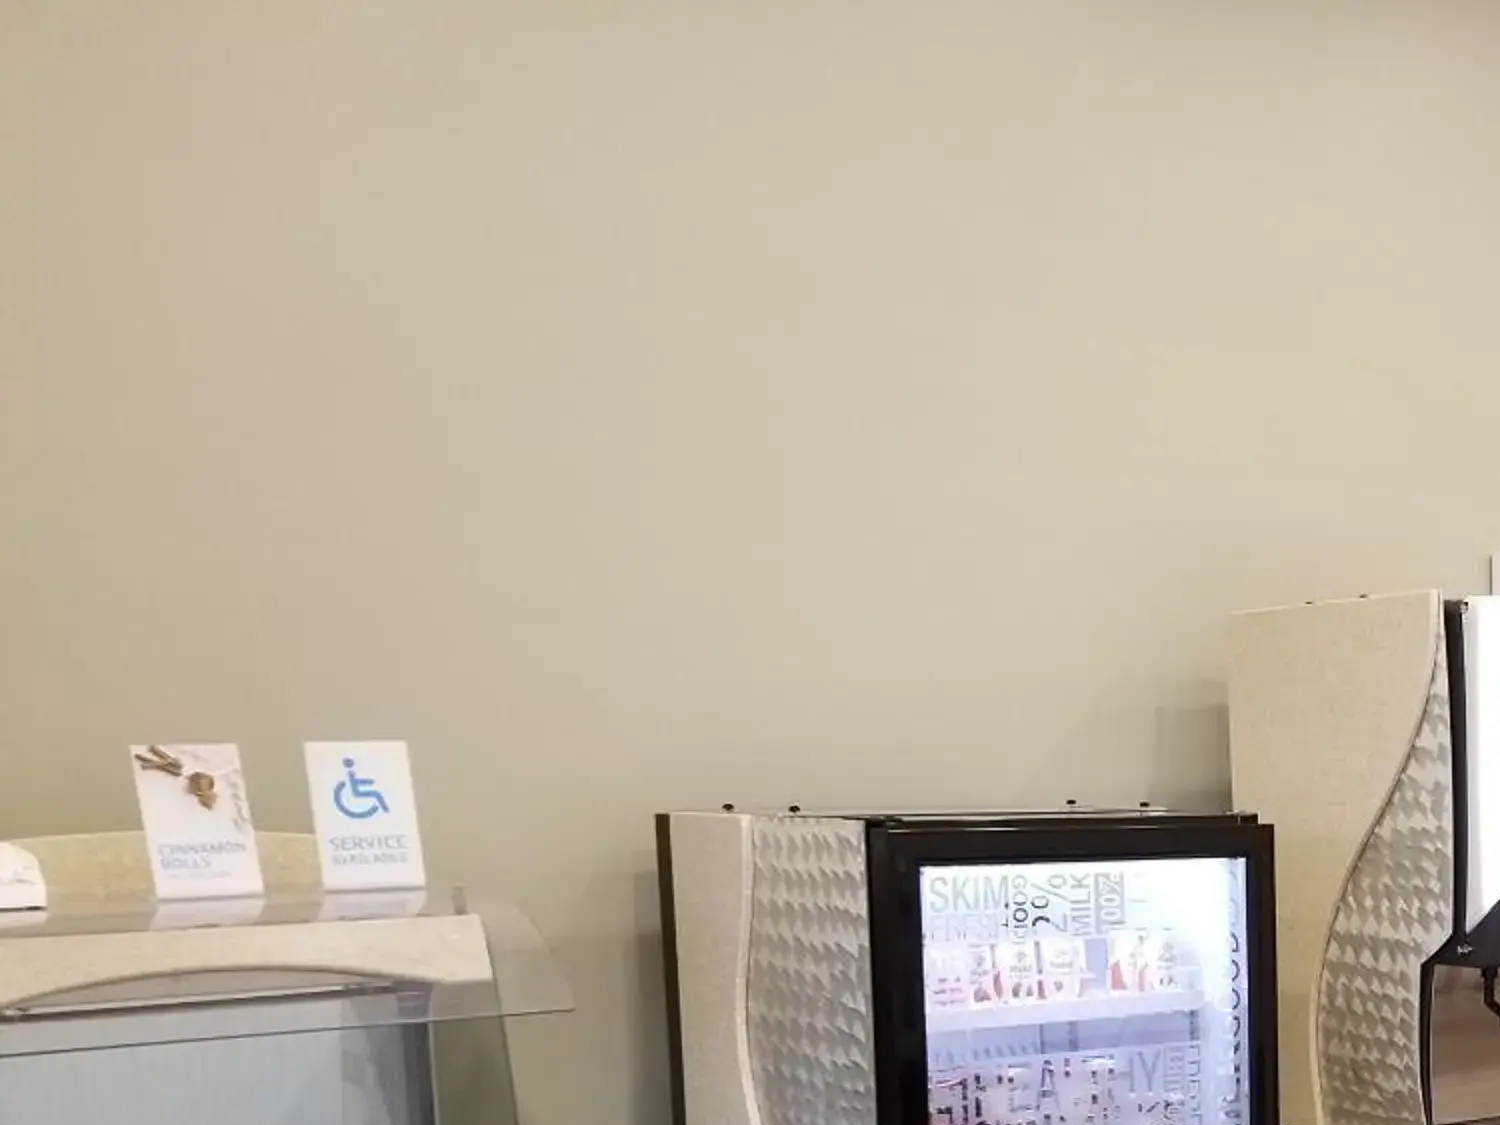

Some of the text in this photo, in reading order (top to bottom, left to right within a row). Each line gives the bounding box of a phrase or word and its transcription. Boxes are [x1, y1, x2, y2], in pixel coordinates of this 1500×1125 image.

[157, 841, 248, 857] CINNAMON
[328, 834, 409, 851] SERVICE
[160, 855, 212, 870] ROLLS
[929, 875, 1009, 913] SKIM
[1069, 873, 1092, 936] MILK
